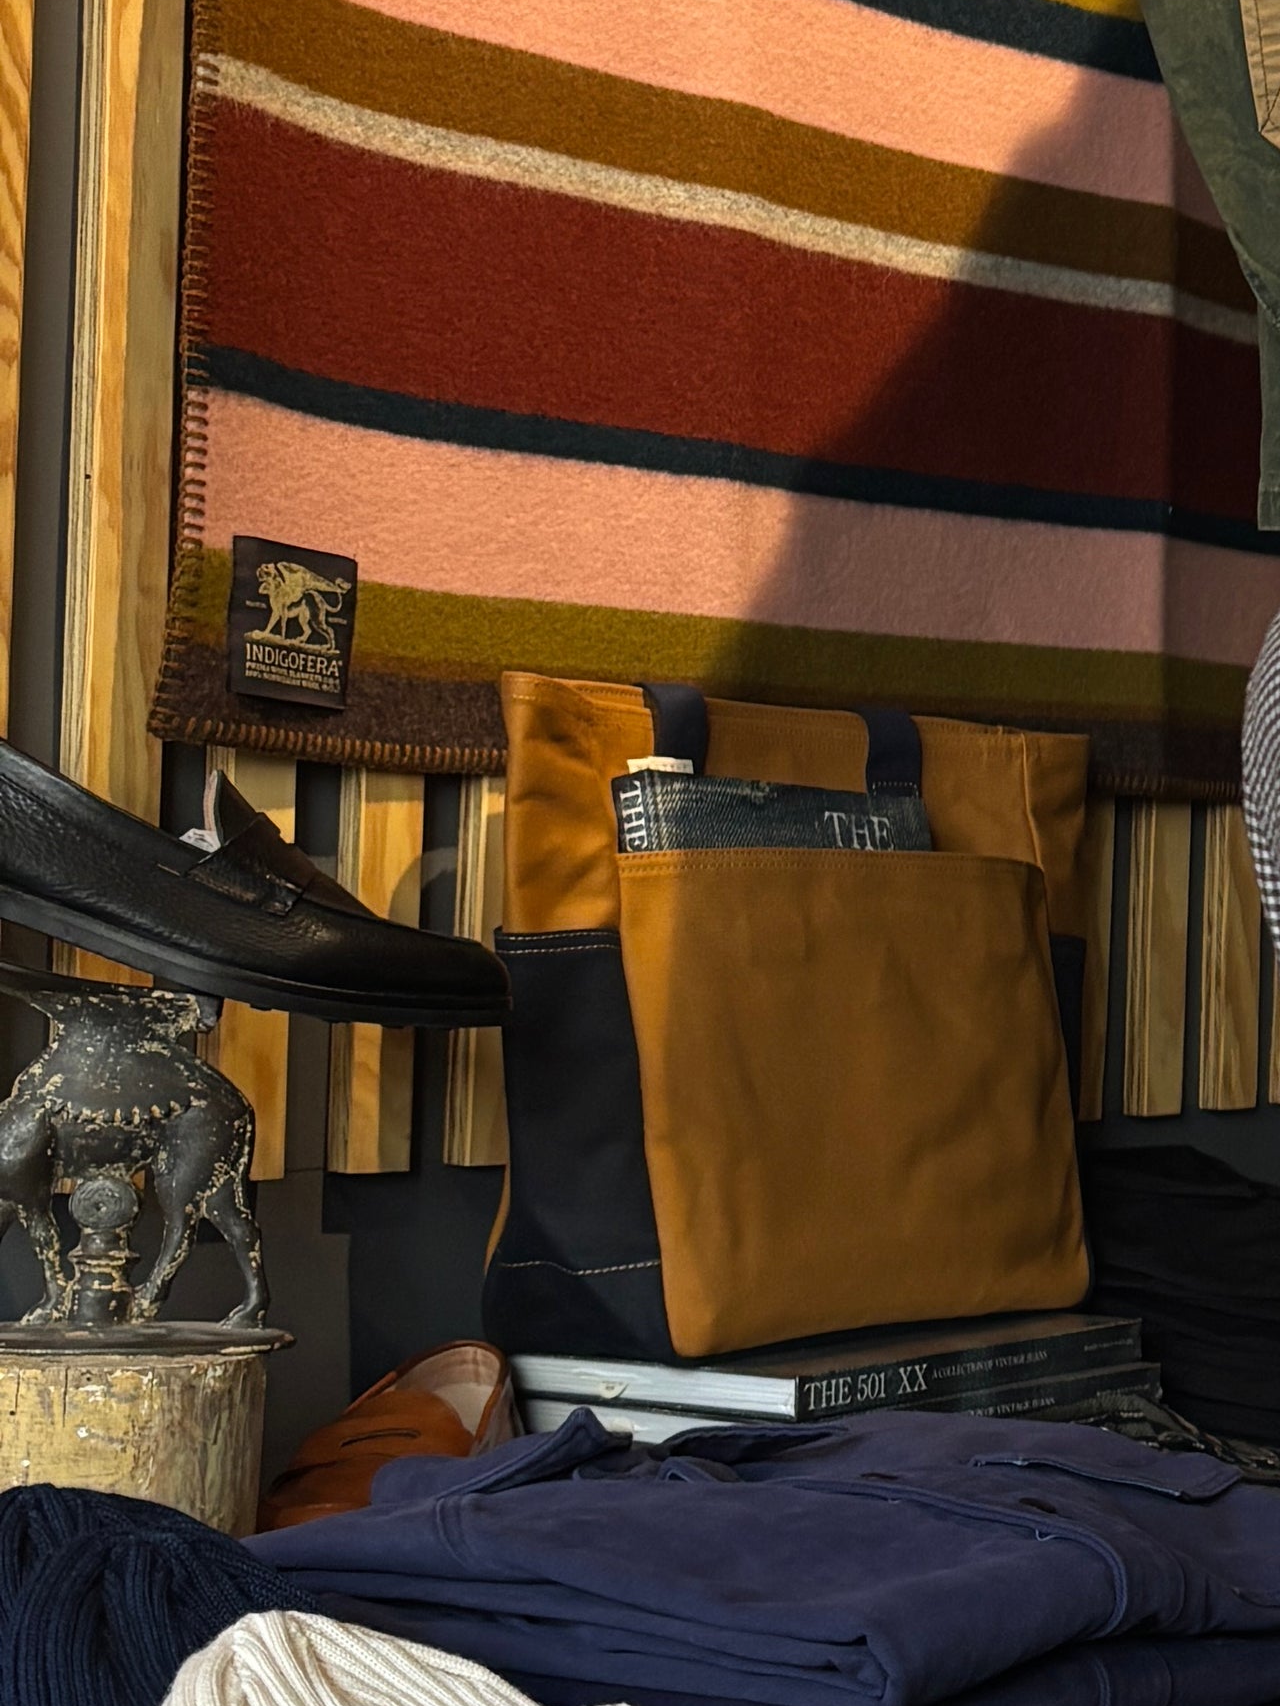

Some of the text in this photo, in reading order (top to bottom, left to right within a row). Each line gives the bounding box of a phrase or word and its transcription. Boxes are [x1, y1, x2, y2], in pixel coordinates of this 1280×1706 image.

[245, 643, 339, 677] INDIGOFERA
[619, 779, 650, 852] THE
[824, 810, 896, 851] THE
[804, 1374, 852, 1411] THE
[857, 1371, 887, 1401] 501
[897, 1363, 928, 1395] XX
